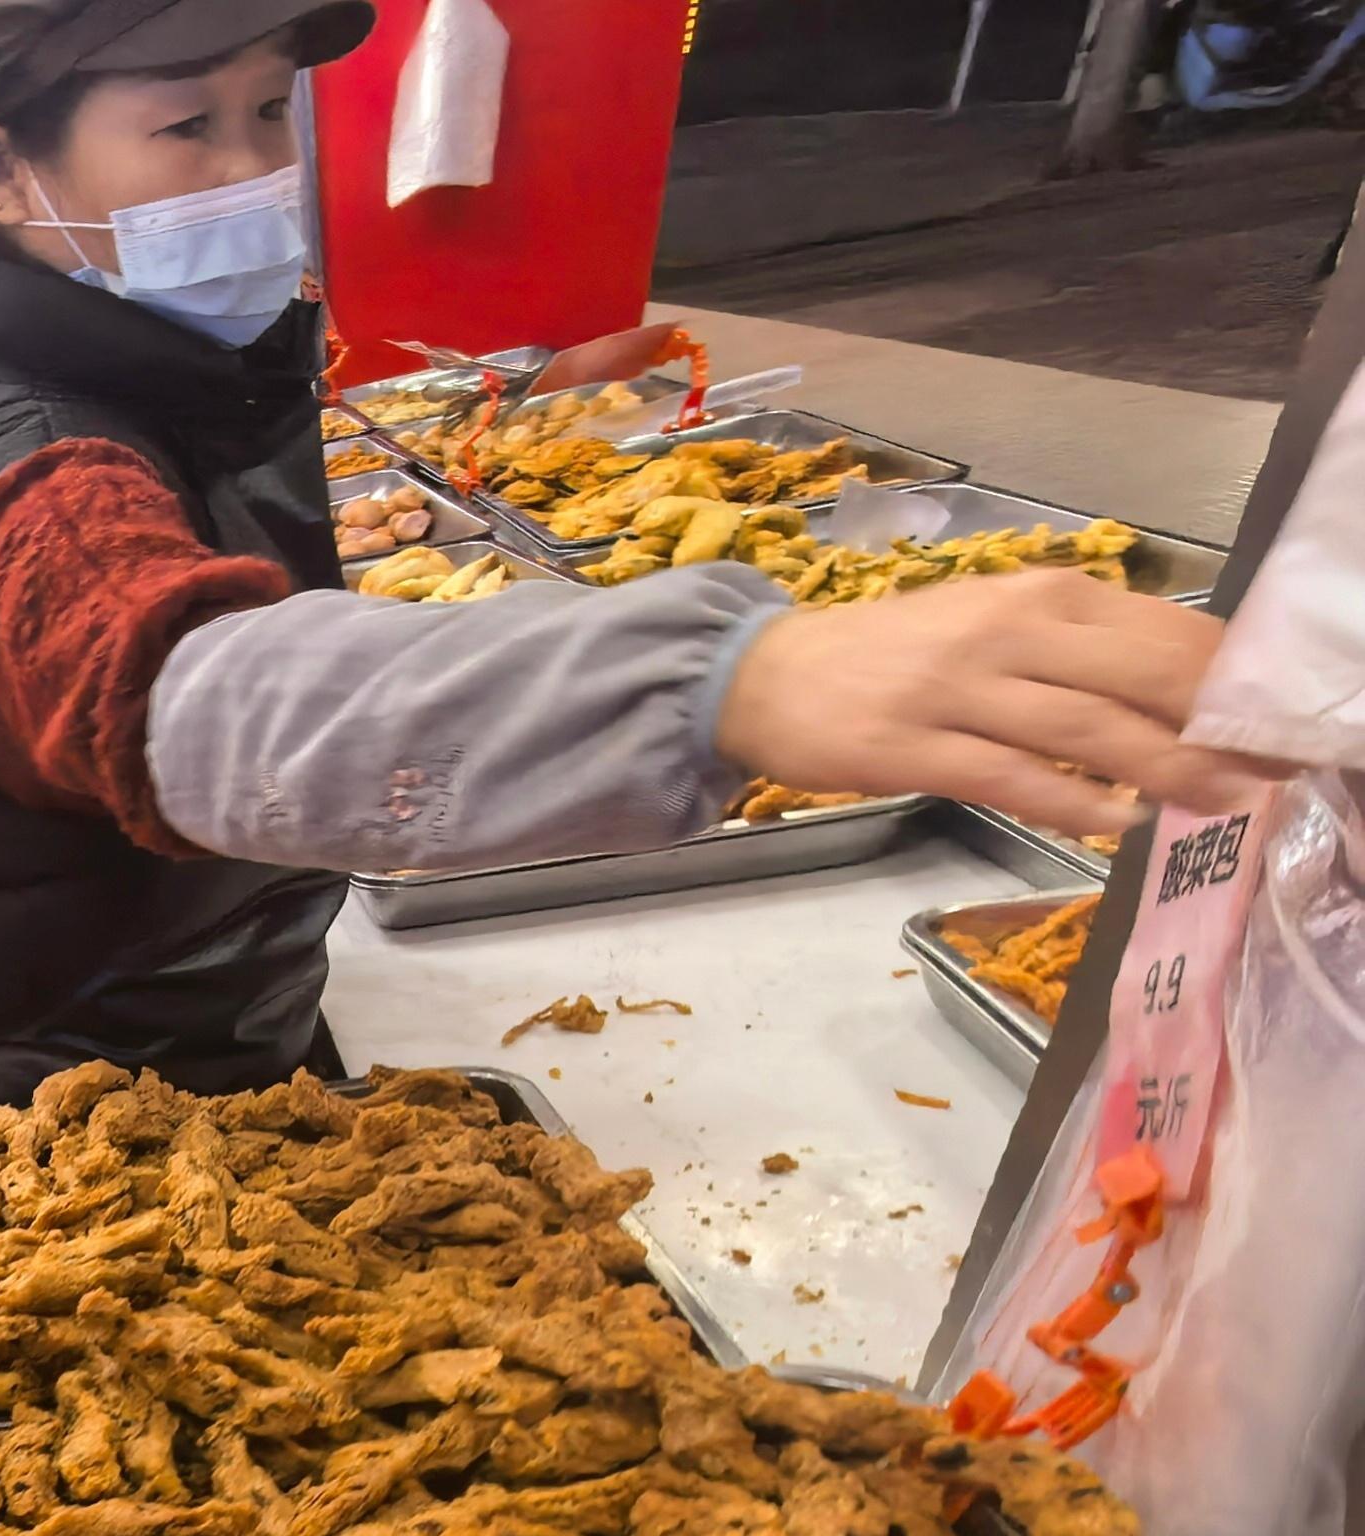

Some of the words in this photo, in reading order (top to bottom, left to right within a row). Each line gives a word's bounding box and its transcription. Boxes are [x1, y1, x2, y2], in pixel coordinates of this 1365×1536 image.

[1156, 812, 1251, 909] 酸菜包
[1142, 953, 1187, 1014] 9.9
[1135, 1073, 1193, 1141] 元/斤
